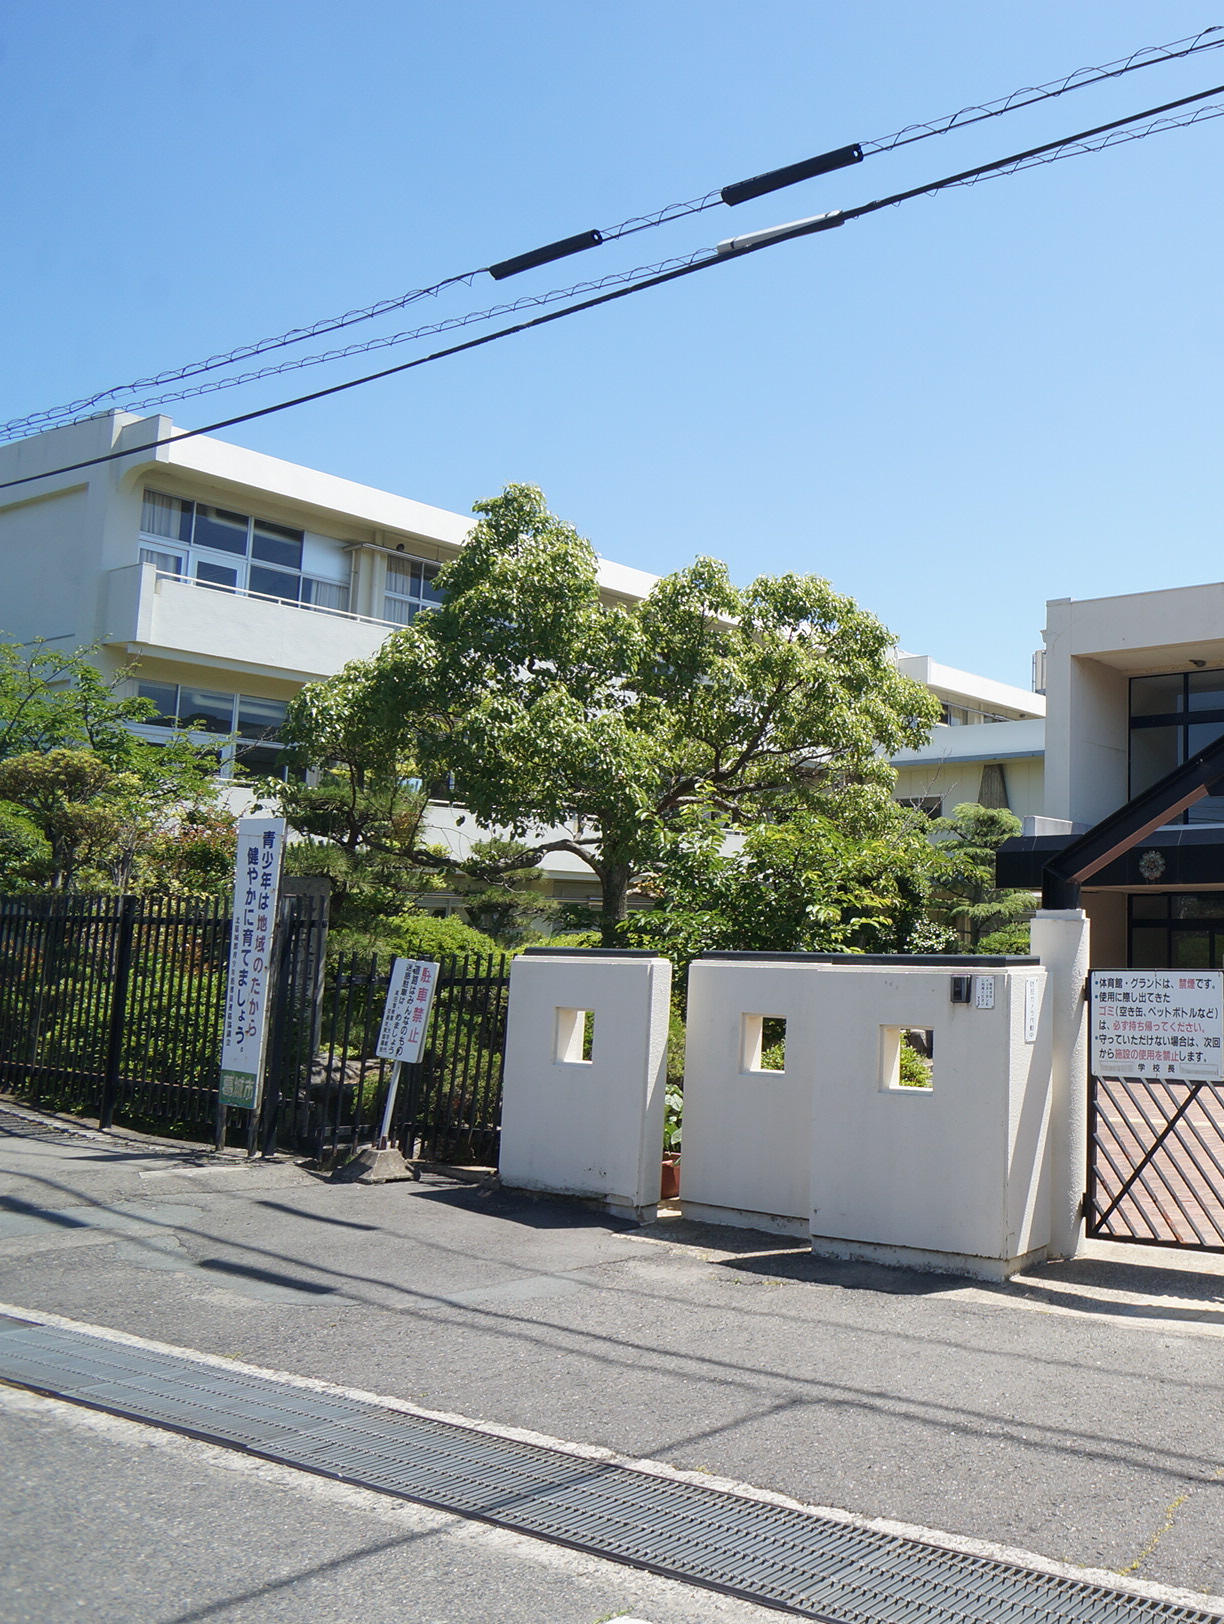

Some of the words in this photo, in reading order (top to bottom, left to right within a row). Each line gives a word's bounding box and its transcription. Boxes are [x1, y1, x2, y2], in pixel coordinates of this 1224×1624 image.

[247, 831, 276, 1037] 青少年は地域のたから
[235, 847, 259, 1053] 健やかに育てましょう。
[1099, 978, 1216, 990] 体育館・グランドは、禁煙です。
[1099, 992, 1171, 1003] 使用に際し出てきた
[388, 963, 413, 1055] 迷惑駐車はめましょう
[396, 965, 421, 1056] 道路はみんなのもの
[407, 967, 432, 1044] 駐車禁止
[1099, 1020, 1206, 1034] は、必ず持ち帰ってください。
[1099, 1034, 1221, 1049] 守っていただけない場合は、次回
[1099, 1048, 1208, 1063] から施設の使用を禁止します。
[222, 1074, 255, 1101] 葛城市
